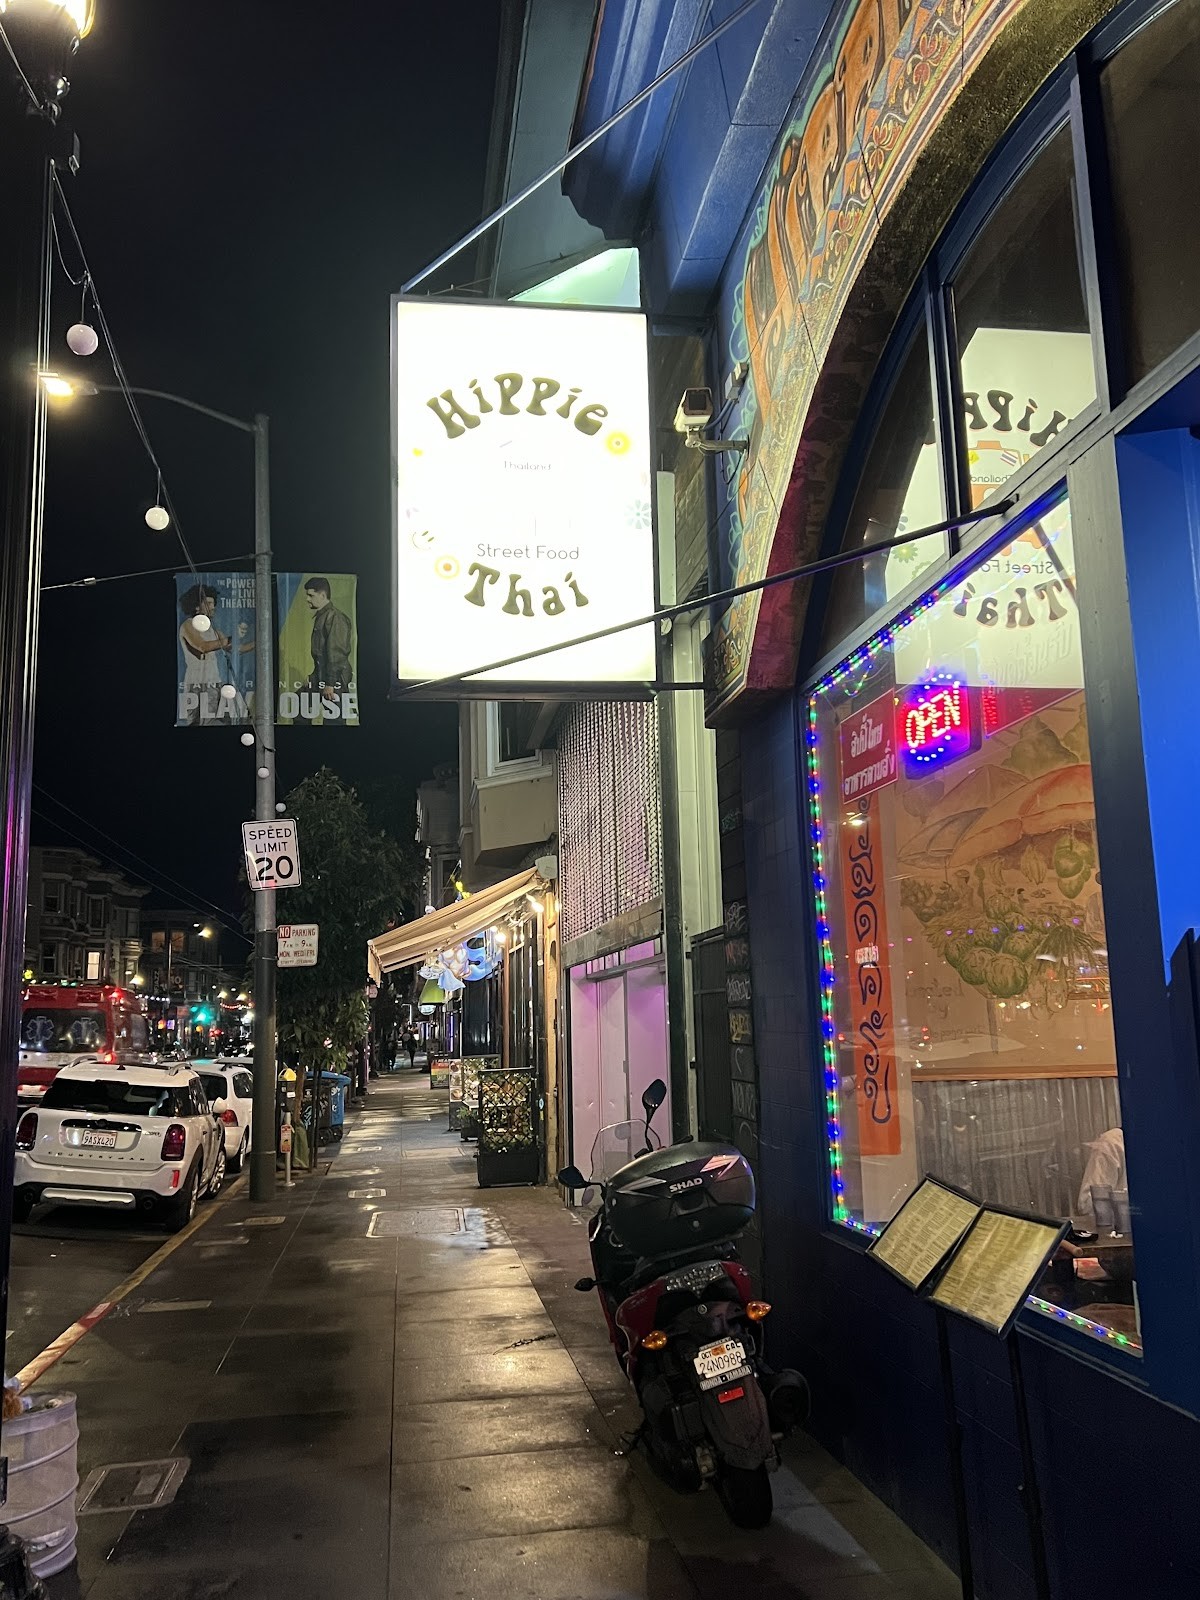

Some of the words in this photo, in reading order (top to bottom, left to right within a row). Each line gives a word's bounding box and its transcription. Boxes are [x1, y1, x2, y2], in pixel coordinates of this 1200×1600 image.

[504, 460, 551, 471] Thailand
[477, 543, 531, 559] Street
[536, 545, 579, 560] Food
[464, 562, 589, 617] Thai
[905, 680, 961, 749] OPEN
[248, 828, 292, 841] SPEED
[255, 842, 288, 854] LIMIT
[255, 855, 294, 882] 20
[279, 926, 291, 938] NO
[292, 928, 316, 937] PARKING
[83, 1135, 115, 1146] 9ASX420
[669, 1177, 703, 1193] SHAD
